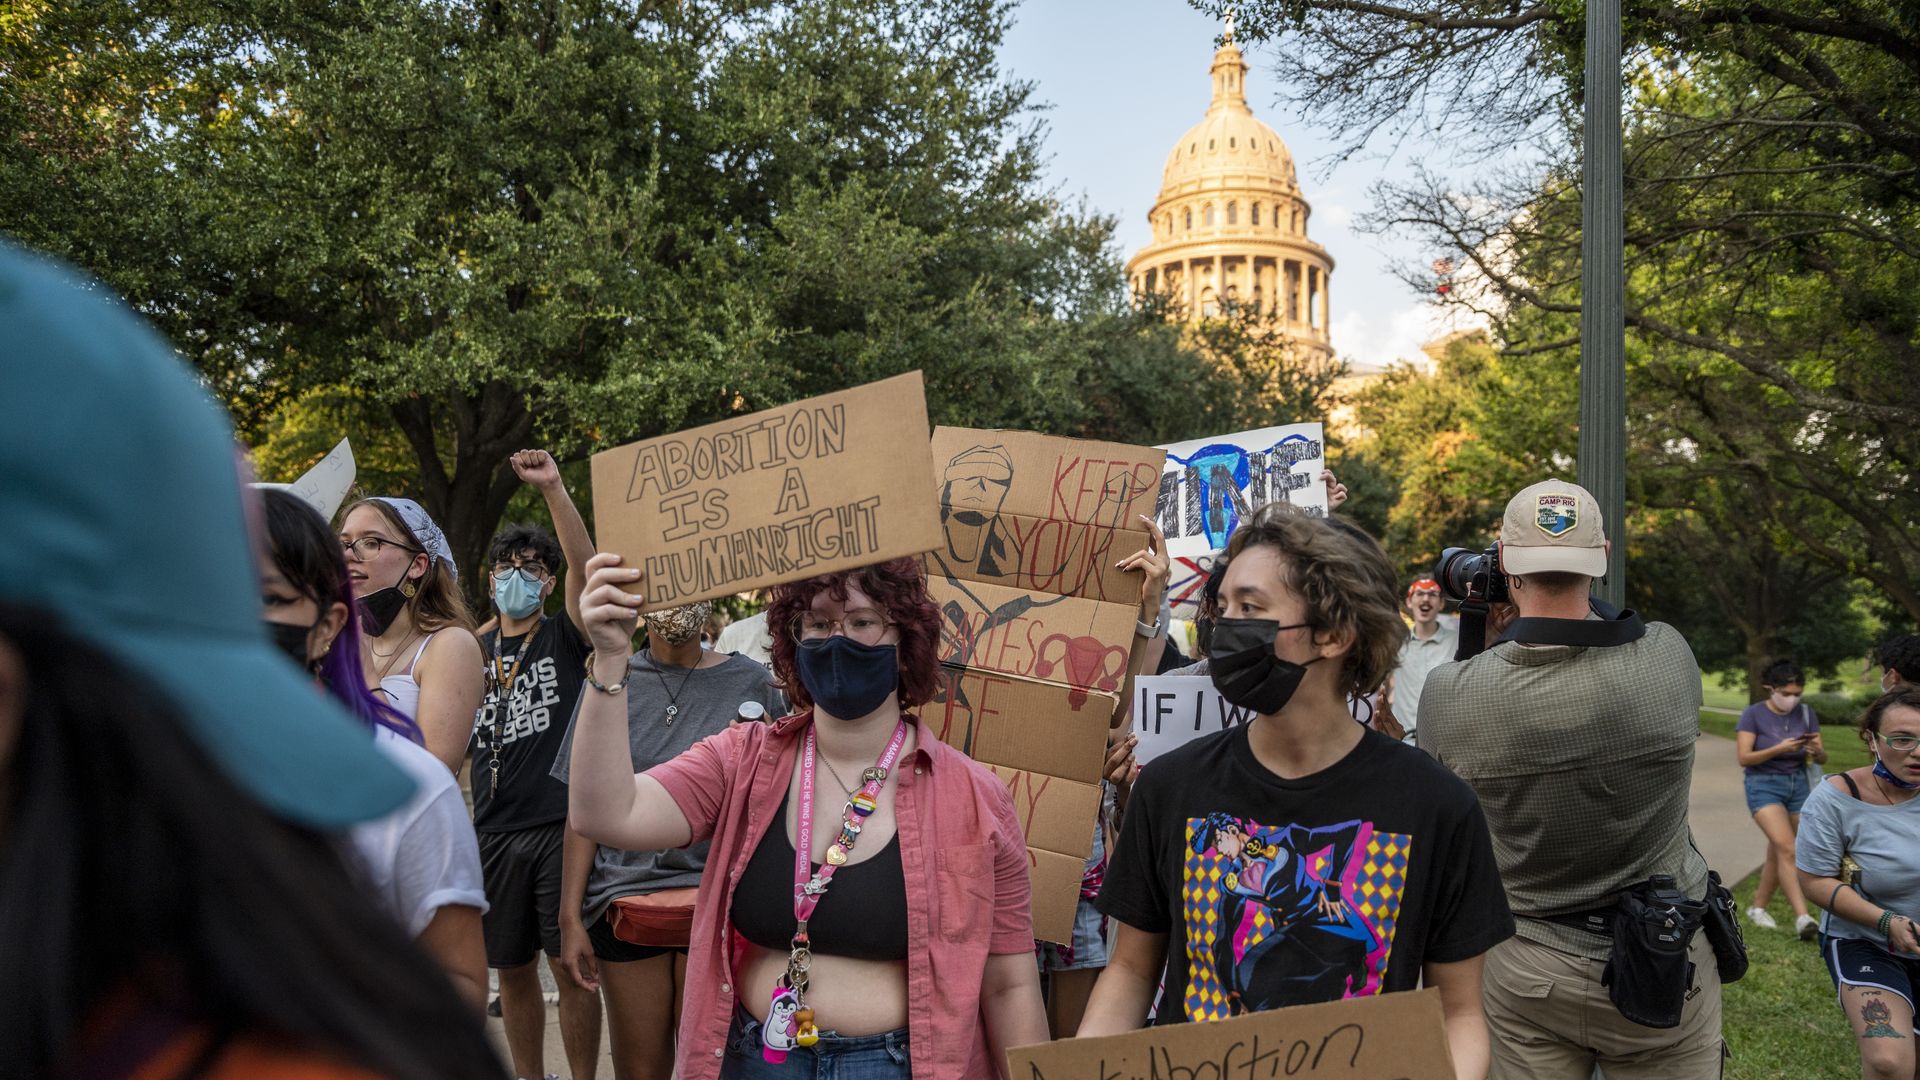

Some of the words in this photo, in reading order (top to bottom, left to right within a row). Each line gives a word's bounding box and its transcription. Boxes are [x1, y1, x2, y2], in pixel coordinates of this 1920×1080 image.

[626, 403, 846, 503] ABORTION
[659, 488, 730, 542] IS
[774, 467, 810, 516] A
[1050, 455, 1158, 530] KEEP
[1562, 499, 1576, 507] RIO
[645, 495, 881, 603] HUMANRIGHT
[1013, 515, 1115, 602] YOUR
[938, 609, 1044, 677] ARIES
[1142, 687, 1176, 735] IF
[1194, 690, 1204, 731] I
[804, 735, 814, 768] MARRIED
[881, 741, 899, 769] MARRIE
[803, 769, 812, 790] ONCE
[803, 791, 812, 801] HE
[802, 801, 811, 819] WINS
[800, 828, 809, 849] GOLD
